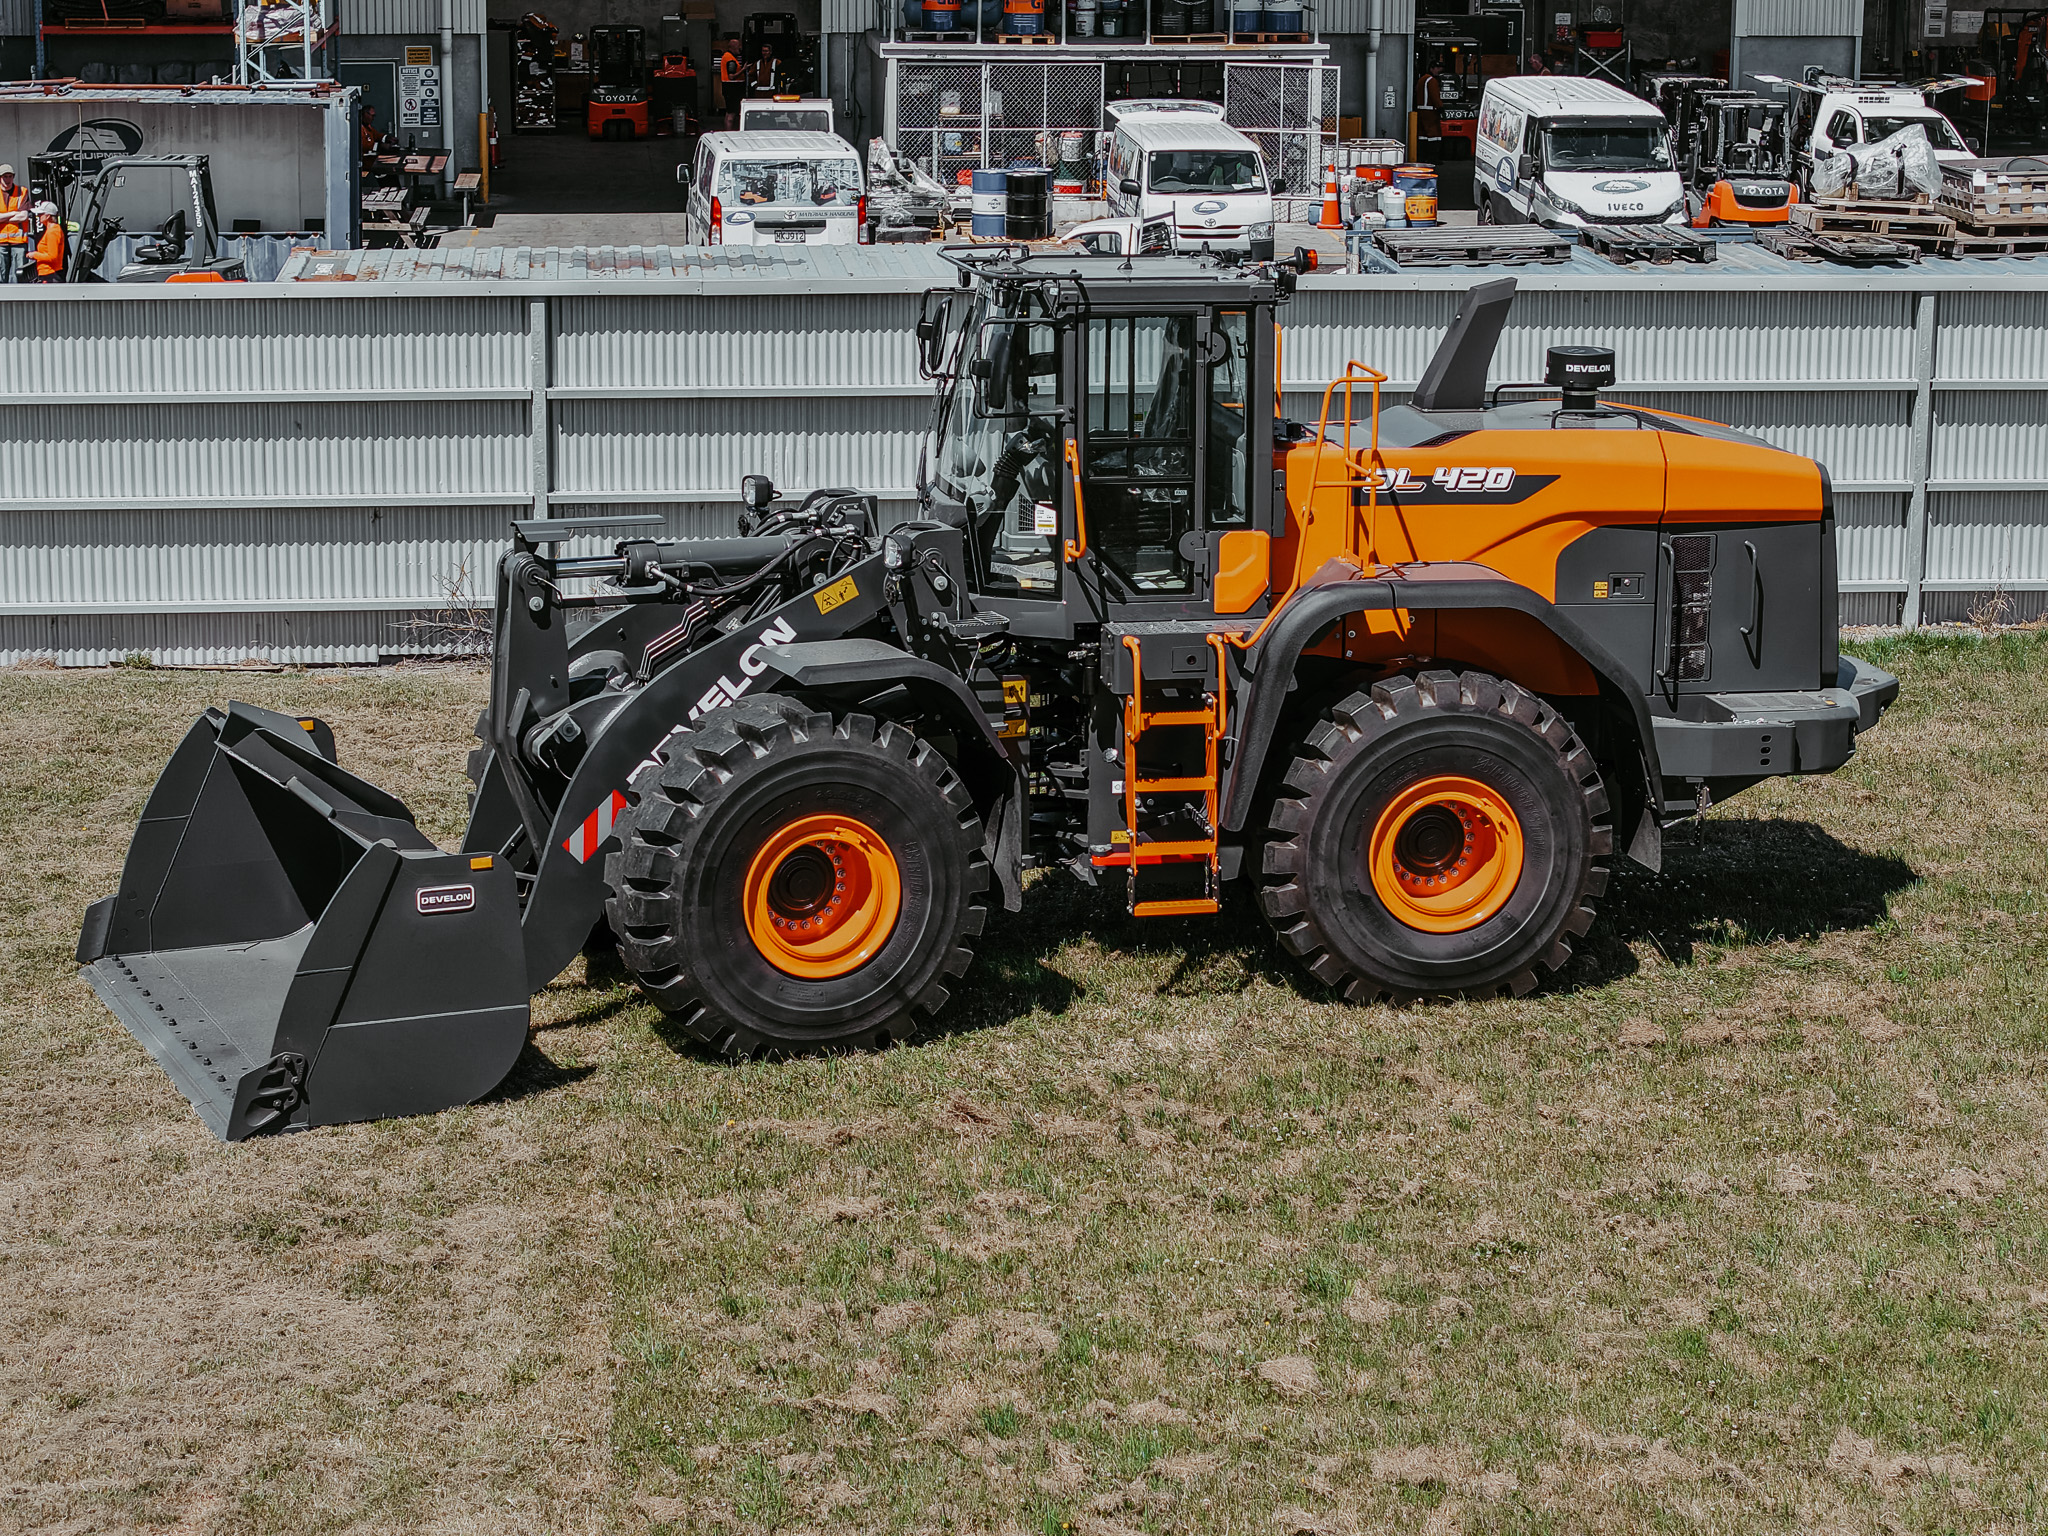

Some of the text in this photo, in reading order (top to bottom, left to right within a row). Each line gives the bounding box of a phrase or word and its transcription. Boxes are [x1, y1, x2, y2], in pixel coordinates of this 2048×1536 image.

[1741, 185, 1785, 195] TOYOTA
[1608, 203, 1644, 211] IVECO
[1565, 364, 1611, 373] DEVELON
[1431, 466, 1516, 493] 420
[420, 892, 471, 905] DEVELON
